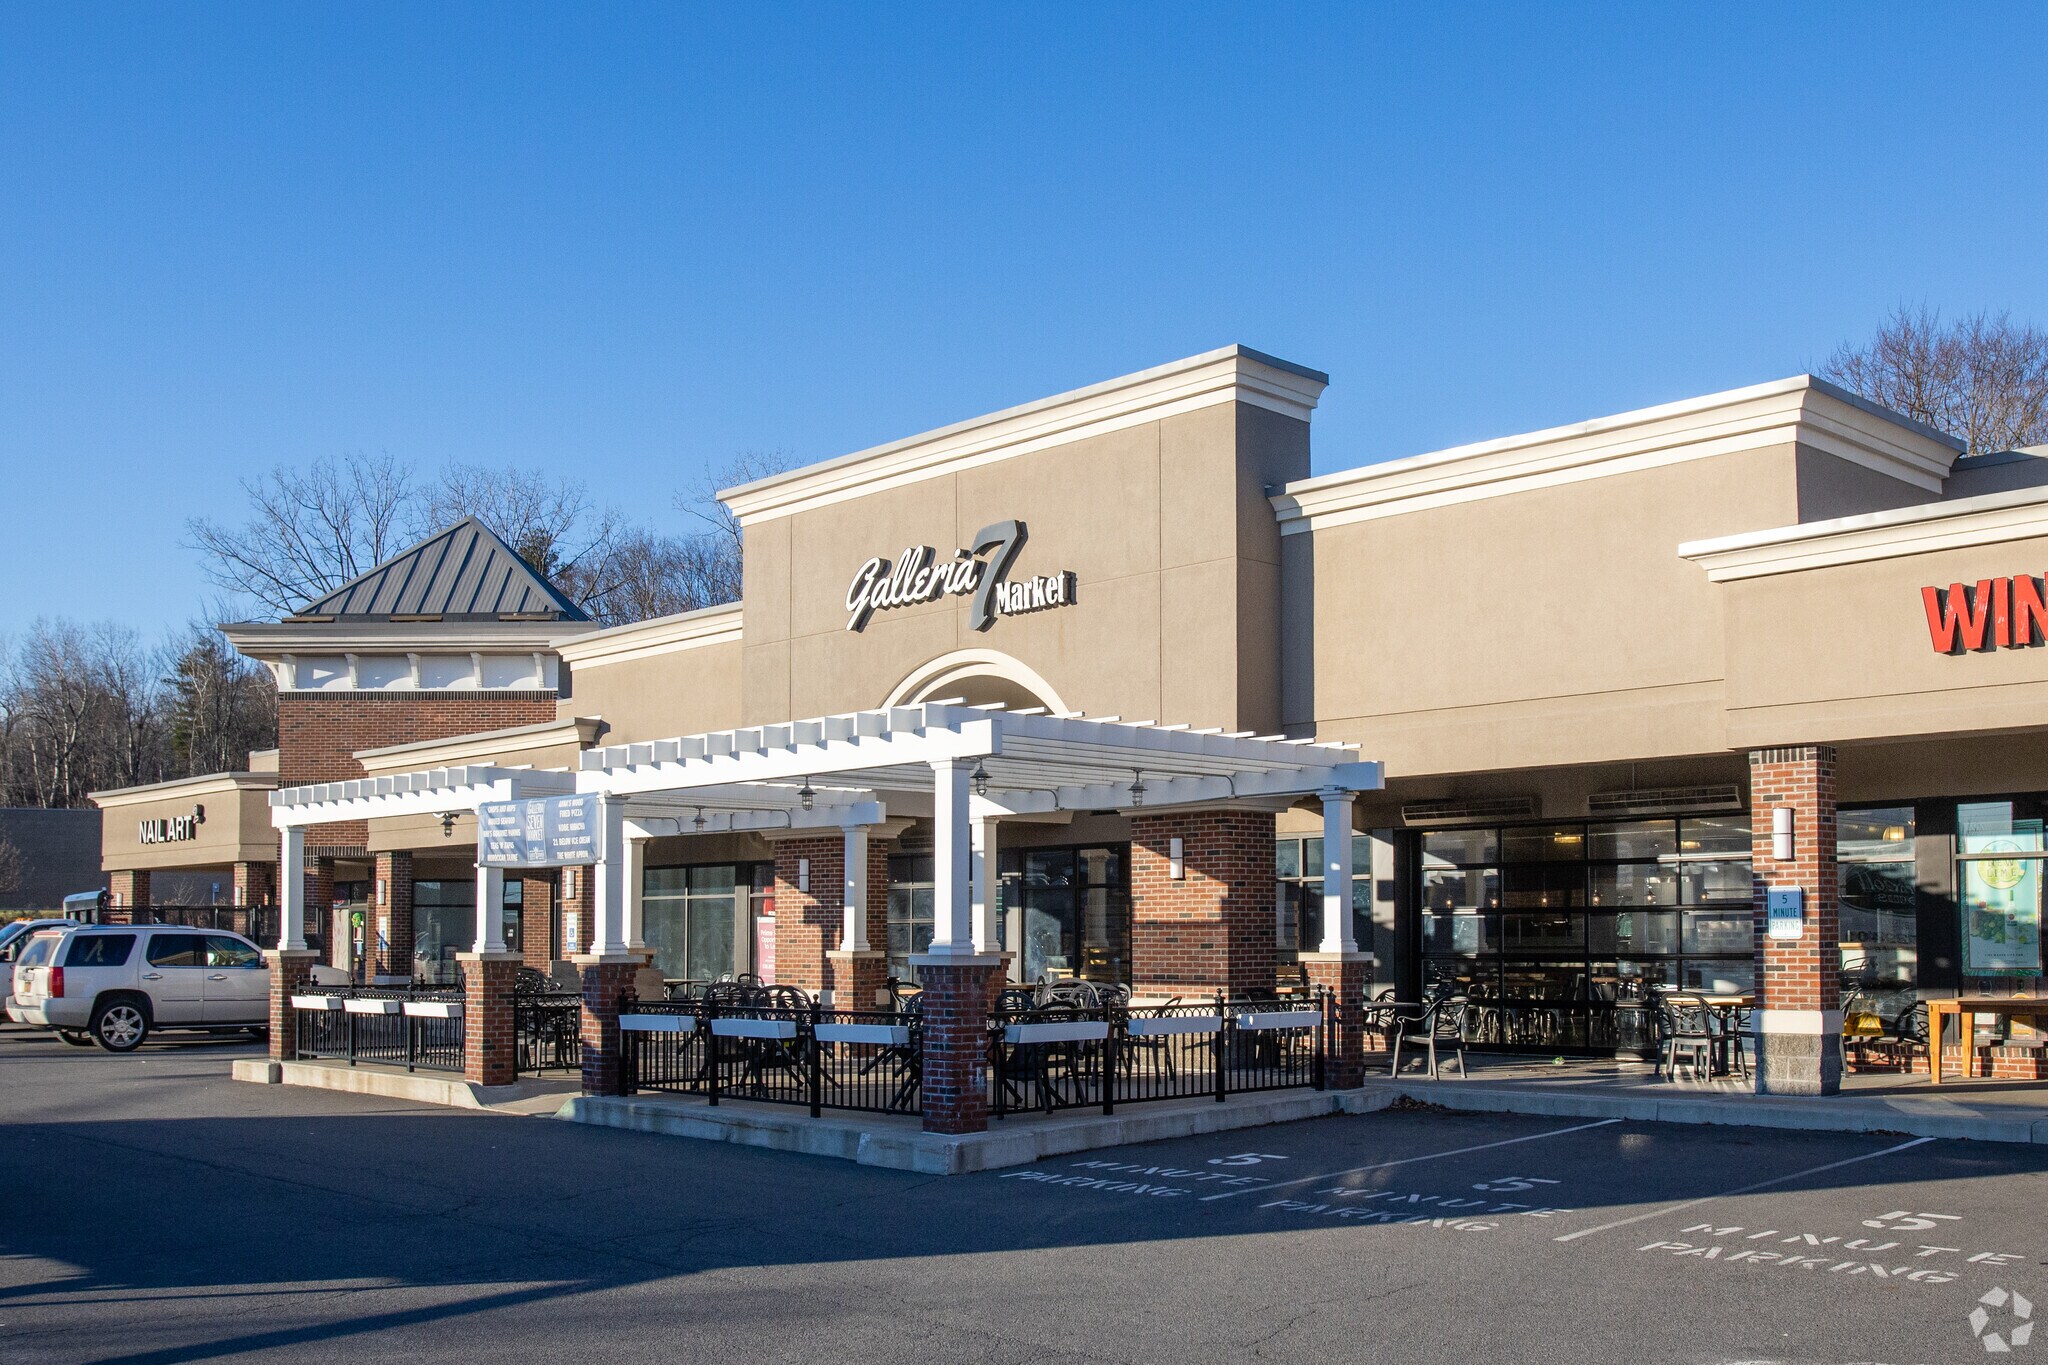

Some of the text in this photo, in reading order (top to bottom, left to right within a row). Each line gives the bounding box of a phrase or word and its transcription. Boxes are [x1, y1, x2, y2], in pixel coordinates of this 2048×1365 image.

[969, 520, 1021, 631] 7
[846, 545, 978, 631] Galleria
[996, 569, 1067, 614] Market
[527, 814, 544, 830] SEVEN
[571, 808, 583, 817] PIZZA
[140, 816, 192, 844] NAIL ART
[527, 830, 543, 842] MARKET
[559, 838, 571, 846] BELOW
[579, 836, 591, 845] CREAM
[1986, 868, 2017, 878] LIME
[1781, 894, 1788, 905] 5
[1772, 907, 1798, 918] MINUTE
[1772, 920, 1800, 930] PARKING
[1207, 1153, 1289, 1166] 5
[1070, 1161, 1270, 1185] MINUTE
[999, 1171, 1192, 1197] PARKING
[1473, 1177, 1561, 1192] 5
[1314, 1187, 1573, 1218] MINUTE
[1259, 1200, 1500, 1232] PARKING
[1862, 1211, 1963, 1230] 5
[1681, 1223, 2025, 1265] MINUTE
[1636, 1241, 1960, 1283] PARKING
